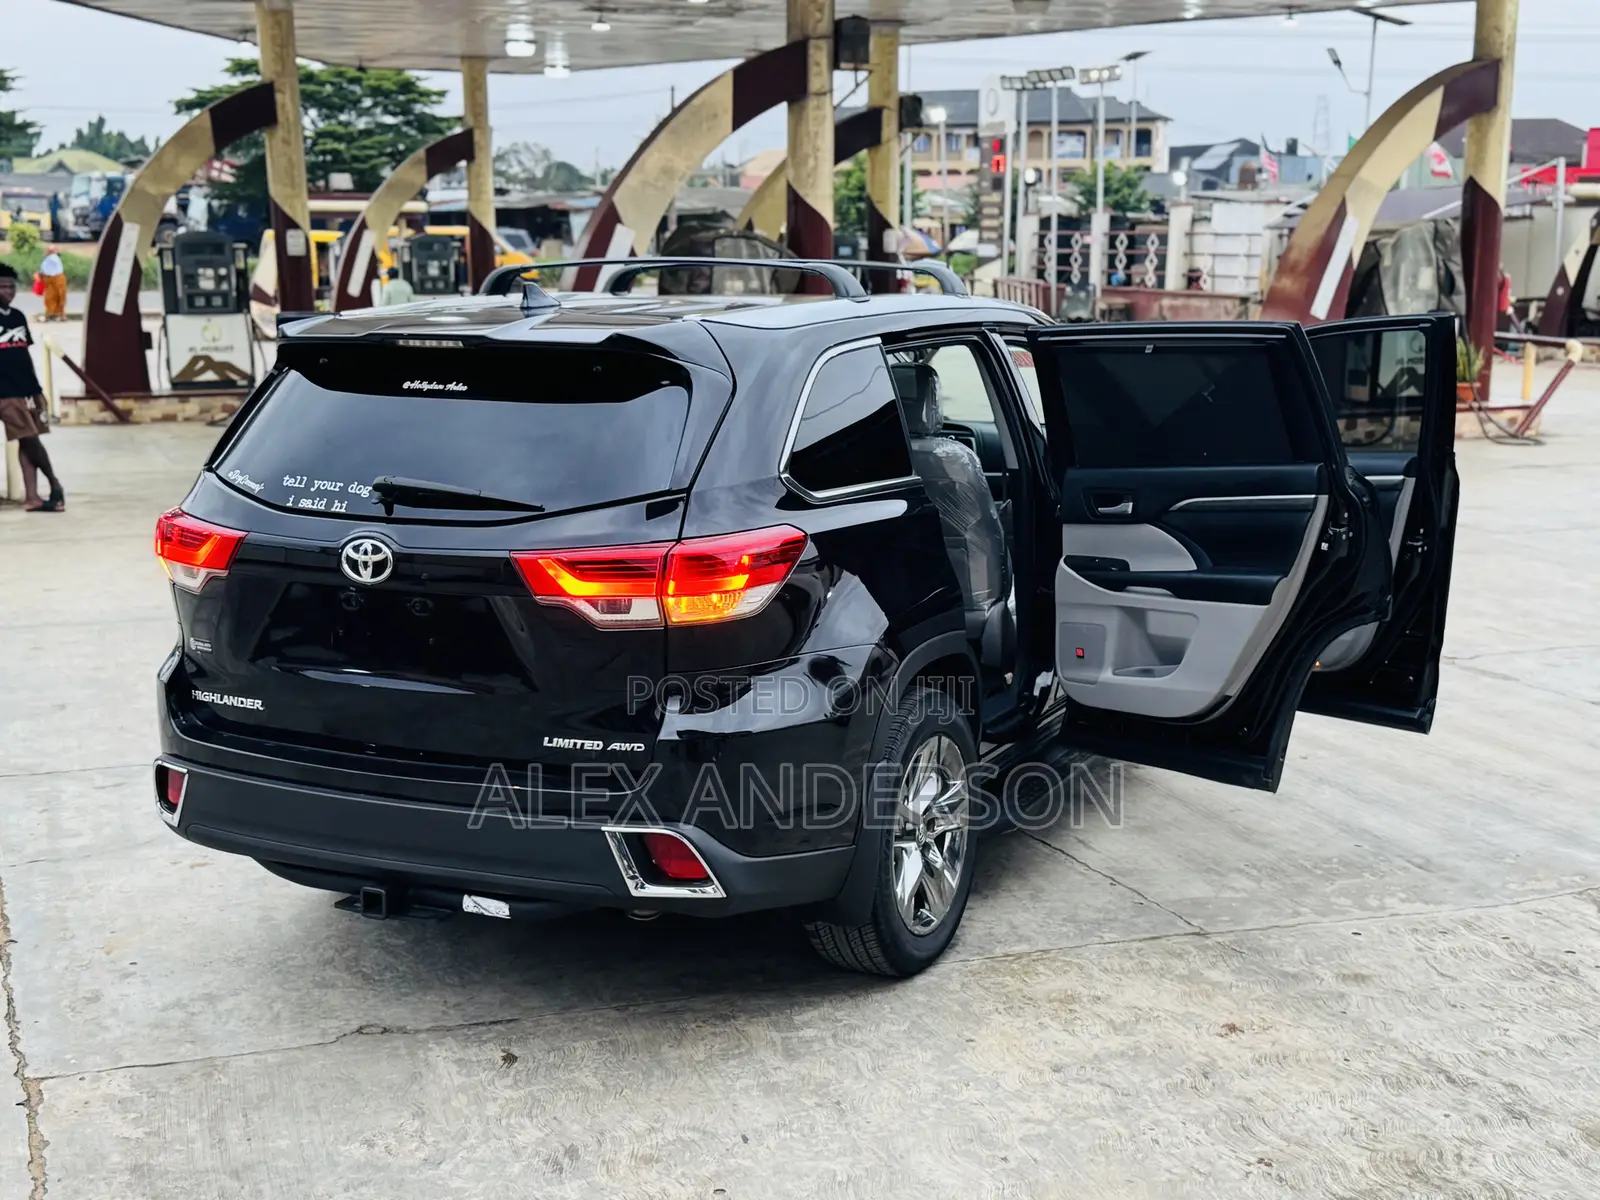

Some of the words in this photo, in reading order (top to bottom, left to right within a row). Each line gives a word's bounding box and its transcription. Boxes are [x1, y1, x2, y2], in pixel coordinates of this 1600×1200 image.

[282, 474, 308, 488] tell
[310, 479, 344, 492] your
[348, 482, 373, 498] dog
[286, 495, 295, 507] i
[298, 497, 327, 510] said
[331, 500, 348, 513] hi
[191, 689, 266, 711] HIGHLANDER
[543, 736, 604, 751] LIMITED
[606, 742, 646, 752] AWD
